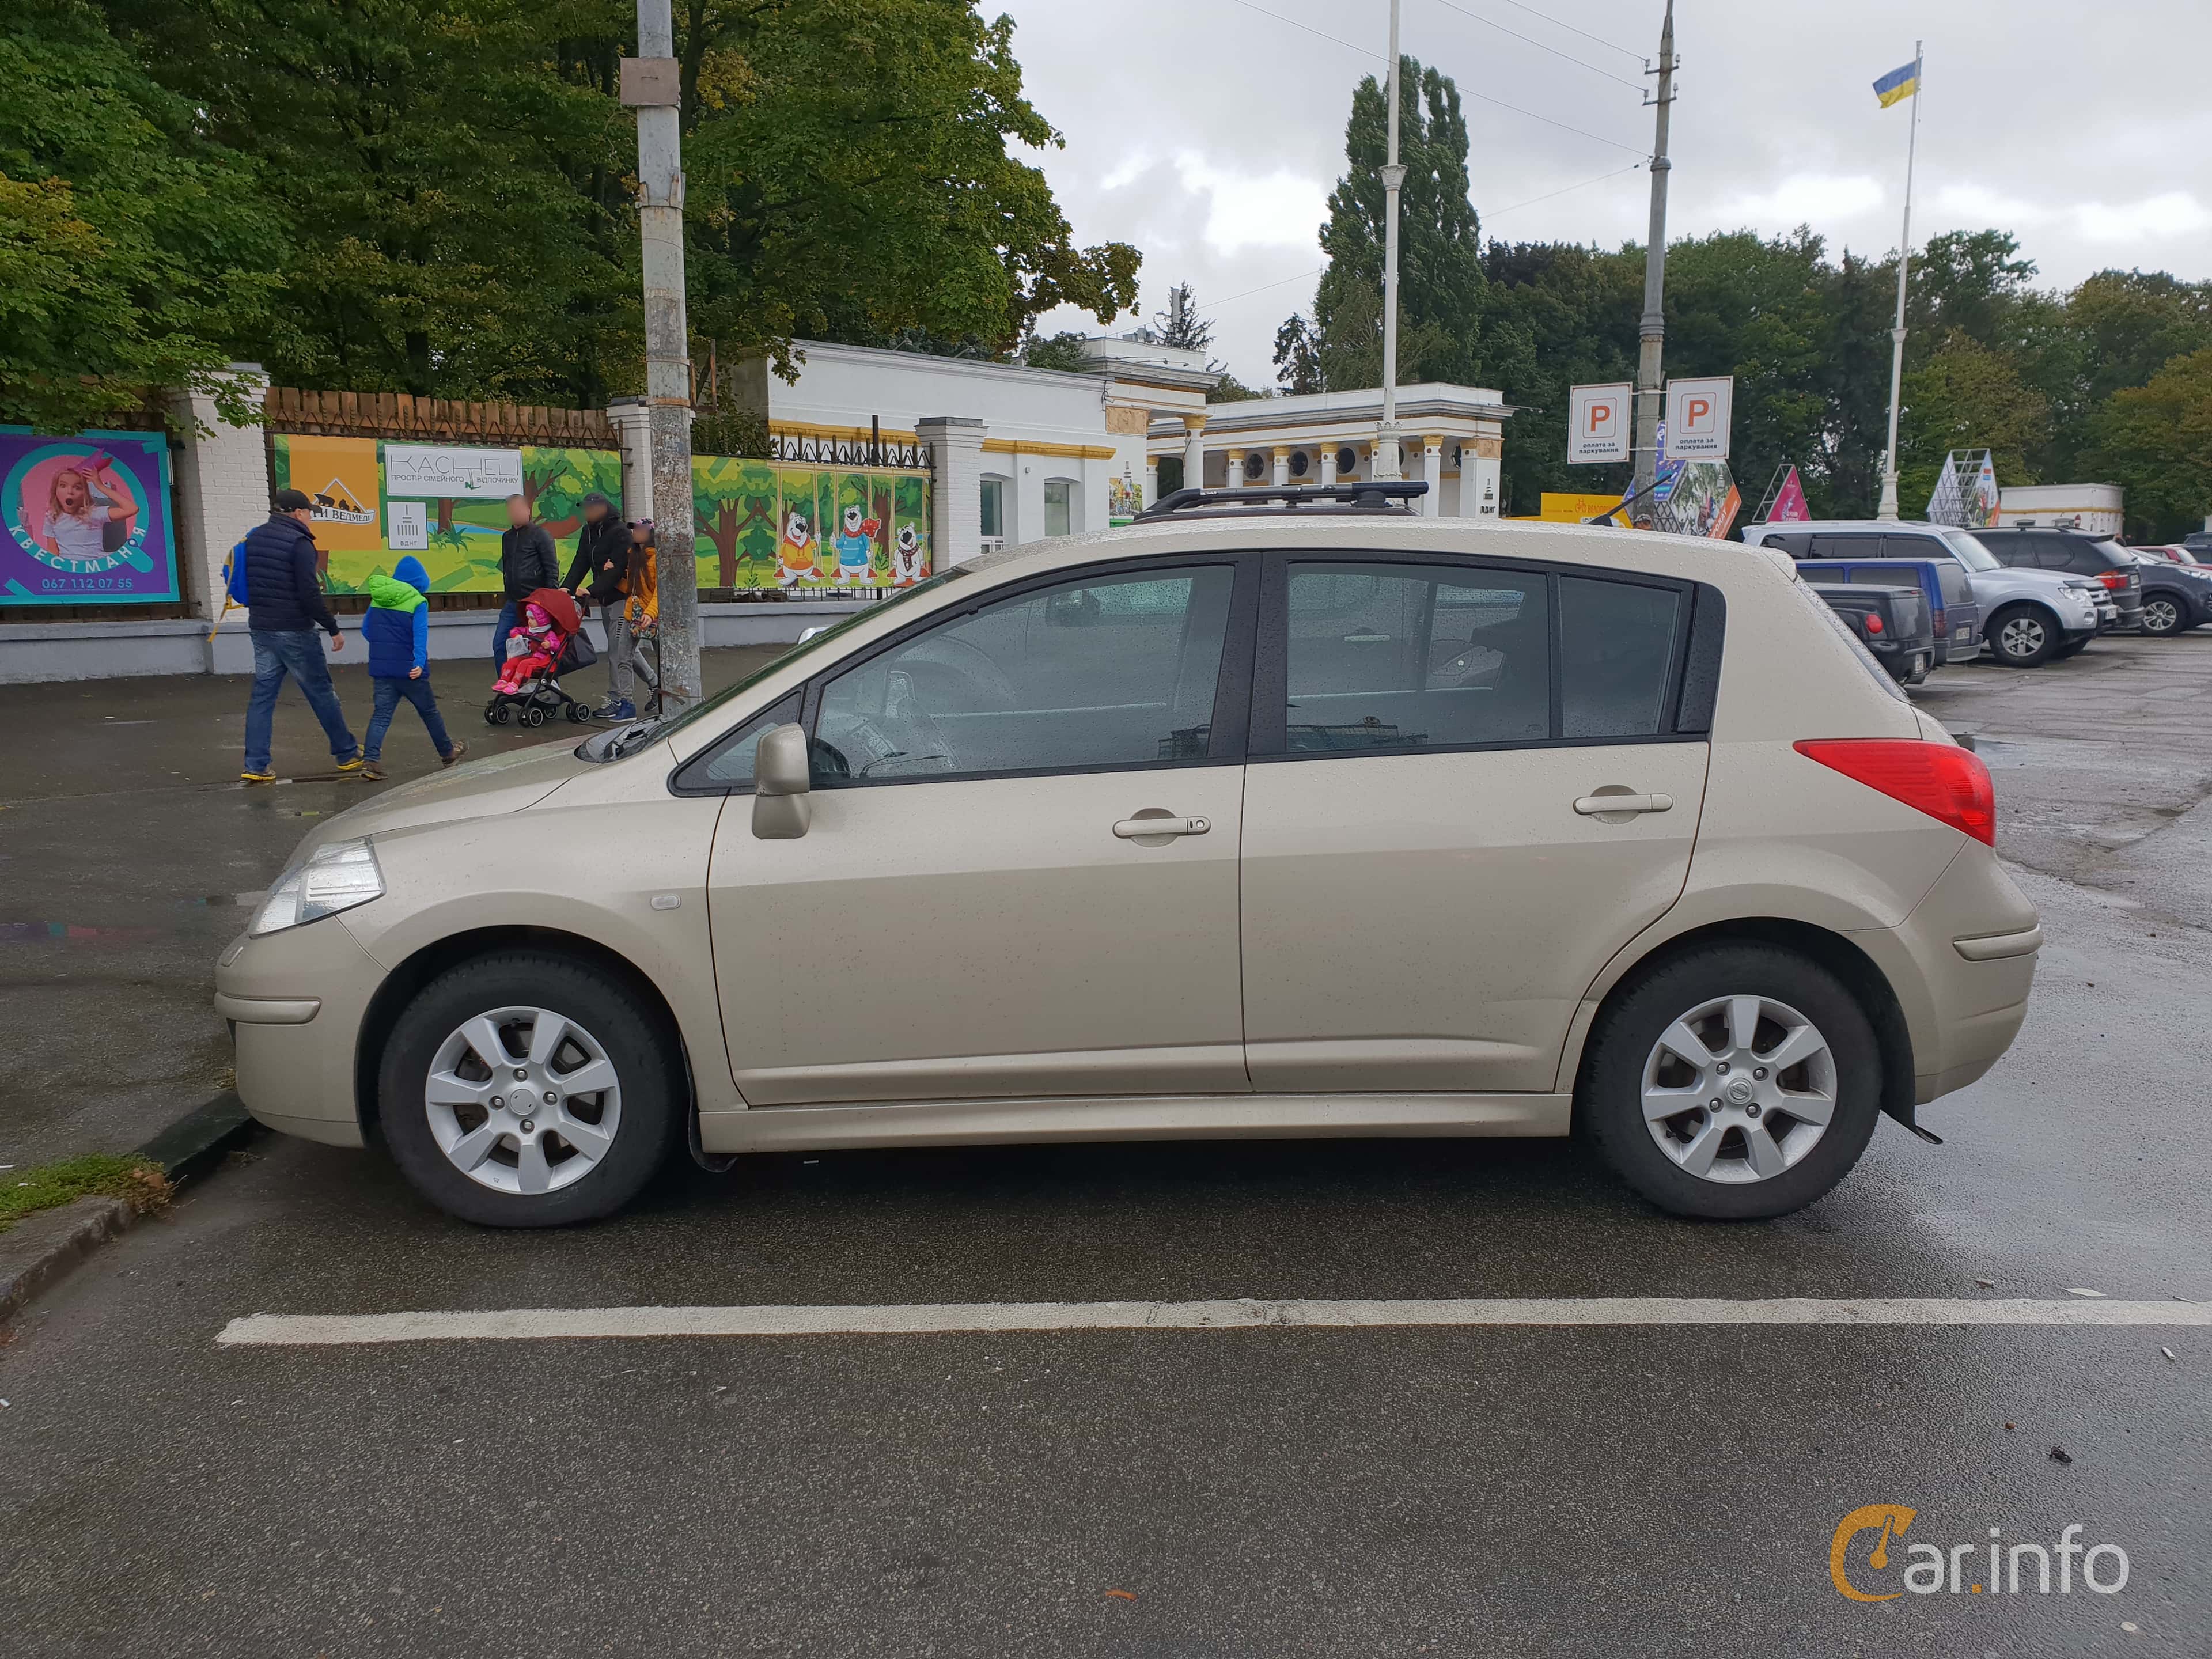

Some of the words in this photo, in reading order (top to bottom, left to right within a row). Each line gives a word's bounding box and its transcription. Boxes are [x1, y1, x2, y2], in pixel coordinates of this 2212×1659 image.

[1590, 405, 1610, 432] P
[1688, 400, 1709, 427] P
[423, 475, 464, 483] СІМЕЙНОГО
[476, 476, 518, 484] ВІДПОЧИНКУ
[41, 578, 66, 589] 067
[71, 578, 94, 589] 112
[98, 578, 113, 589] 07
[118, 578, 132, 589] 55
